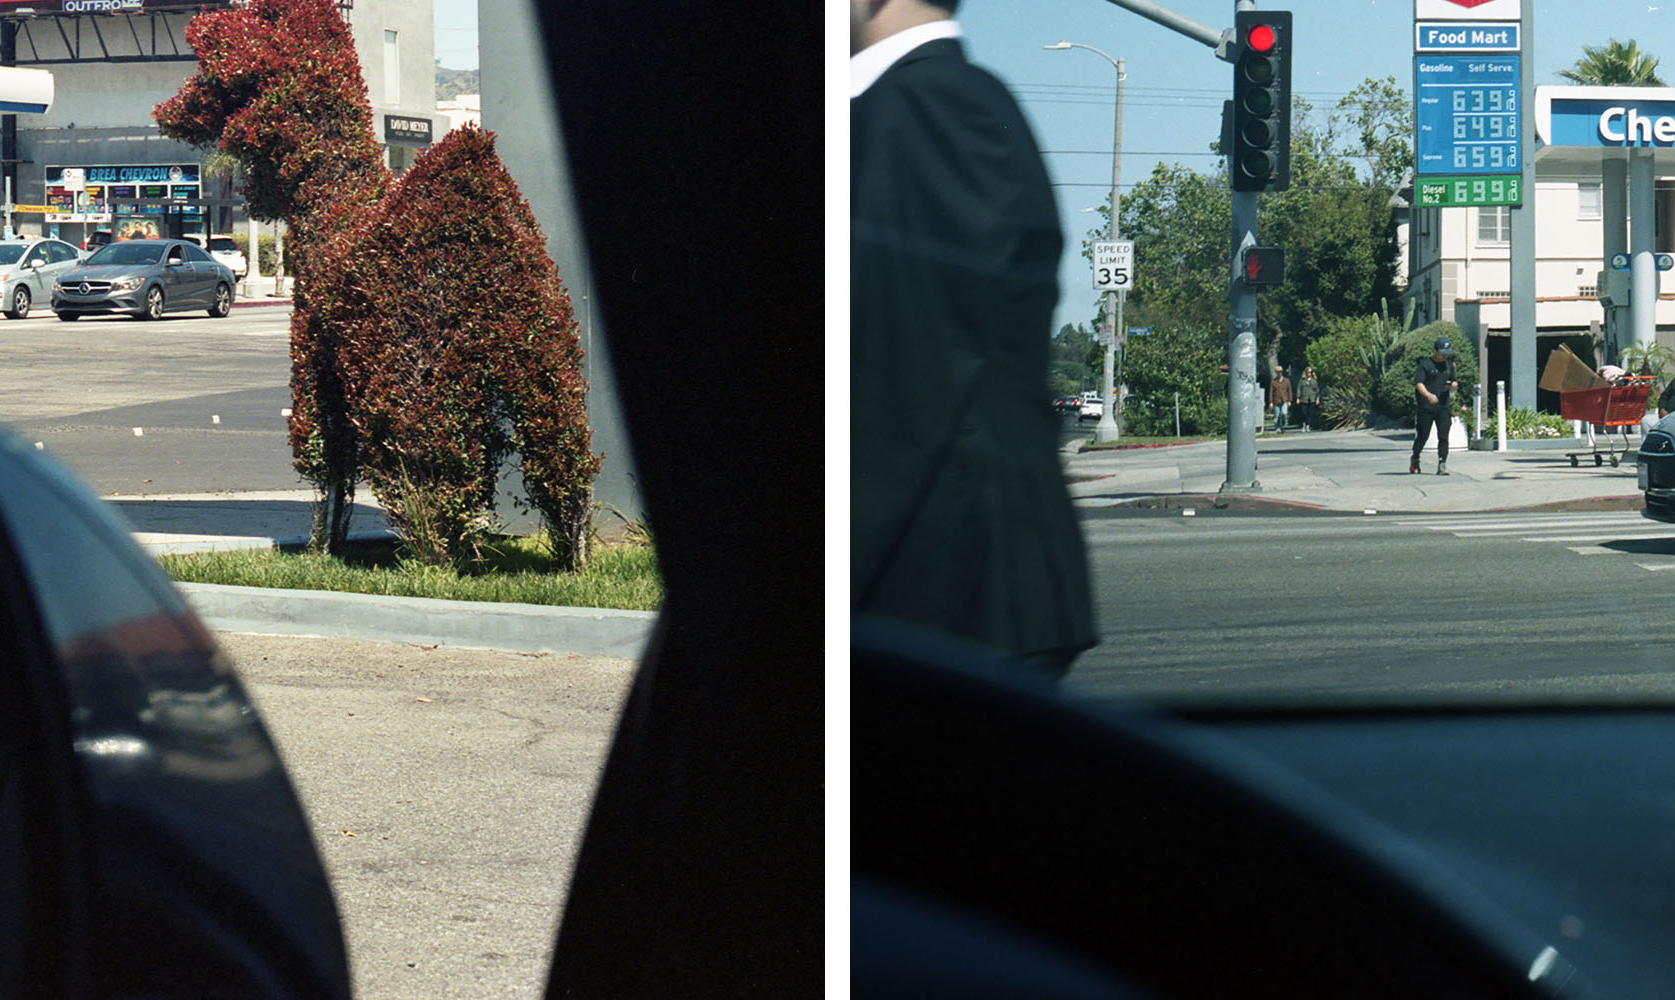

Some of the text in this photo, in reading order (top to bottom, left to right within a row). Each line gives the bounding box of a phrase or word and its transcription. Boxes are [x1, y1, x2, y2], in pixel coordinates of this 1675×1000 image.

[1428, 31, 1508, 44] Food Mart
[1420, 64, 1453, 72] Gasoline
[1468, 64, 1486, 72] Self
[89, 167, 168, 180] BREA CHEVRON
[1422, 184, 1445, 194] Diesel
[1097, 245, 1130, 254] SPEED
[1100, 256, 1126, 264] LIMIT
[1098, 267, 1129, 285] 35
